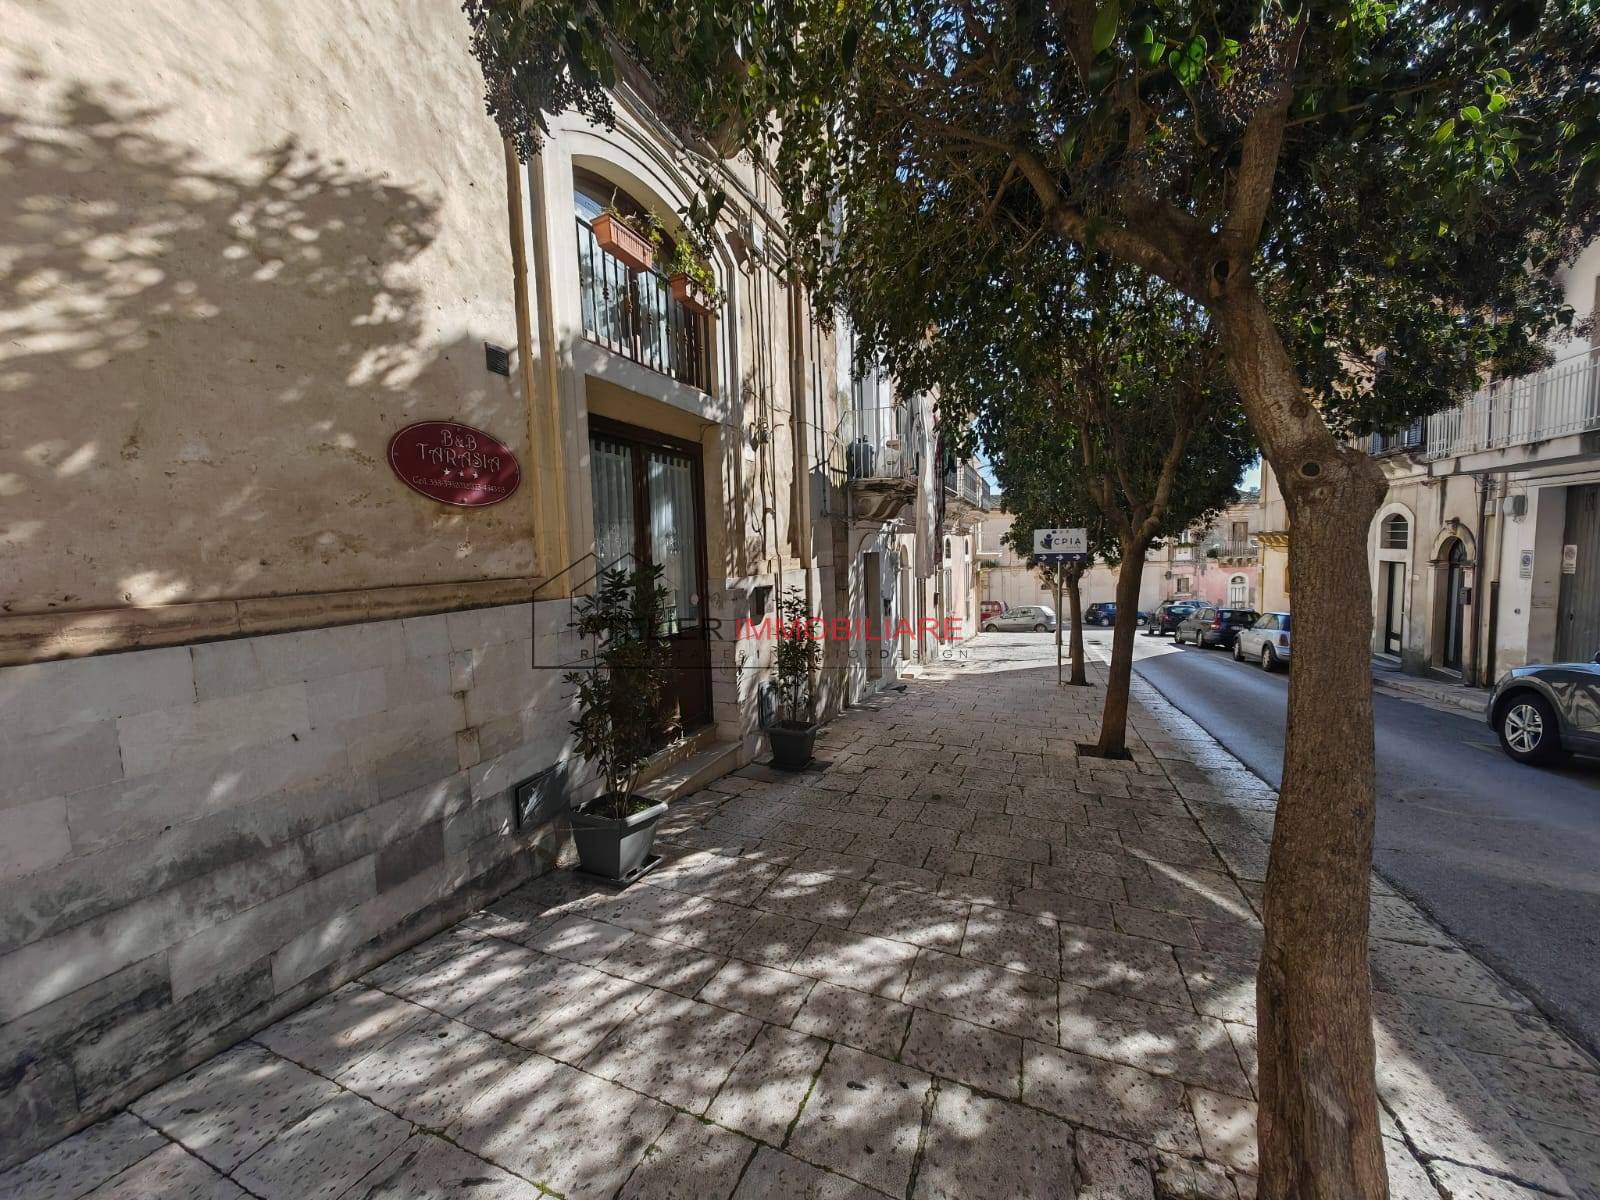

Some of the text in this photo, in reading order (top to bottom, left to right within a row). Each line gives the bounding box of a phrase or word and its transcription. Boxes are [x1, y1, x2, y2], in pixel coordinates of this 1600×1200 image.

[441, 429, 477, 451] B&B
[416, 443, 500, 472] TARASIA
[1053, 537, 1082, 545] CPIA
